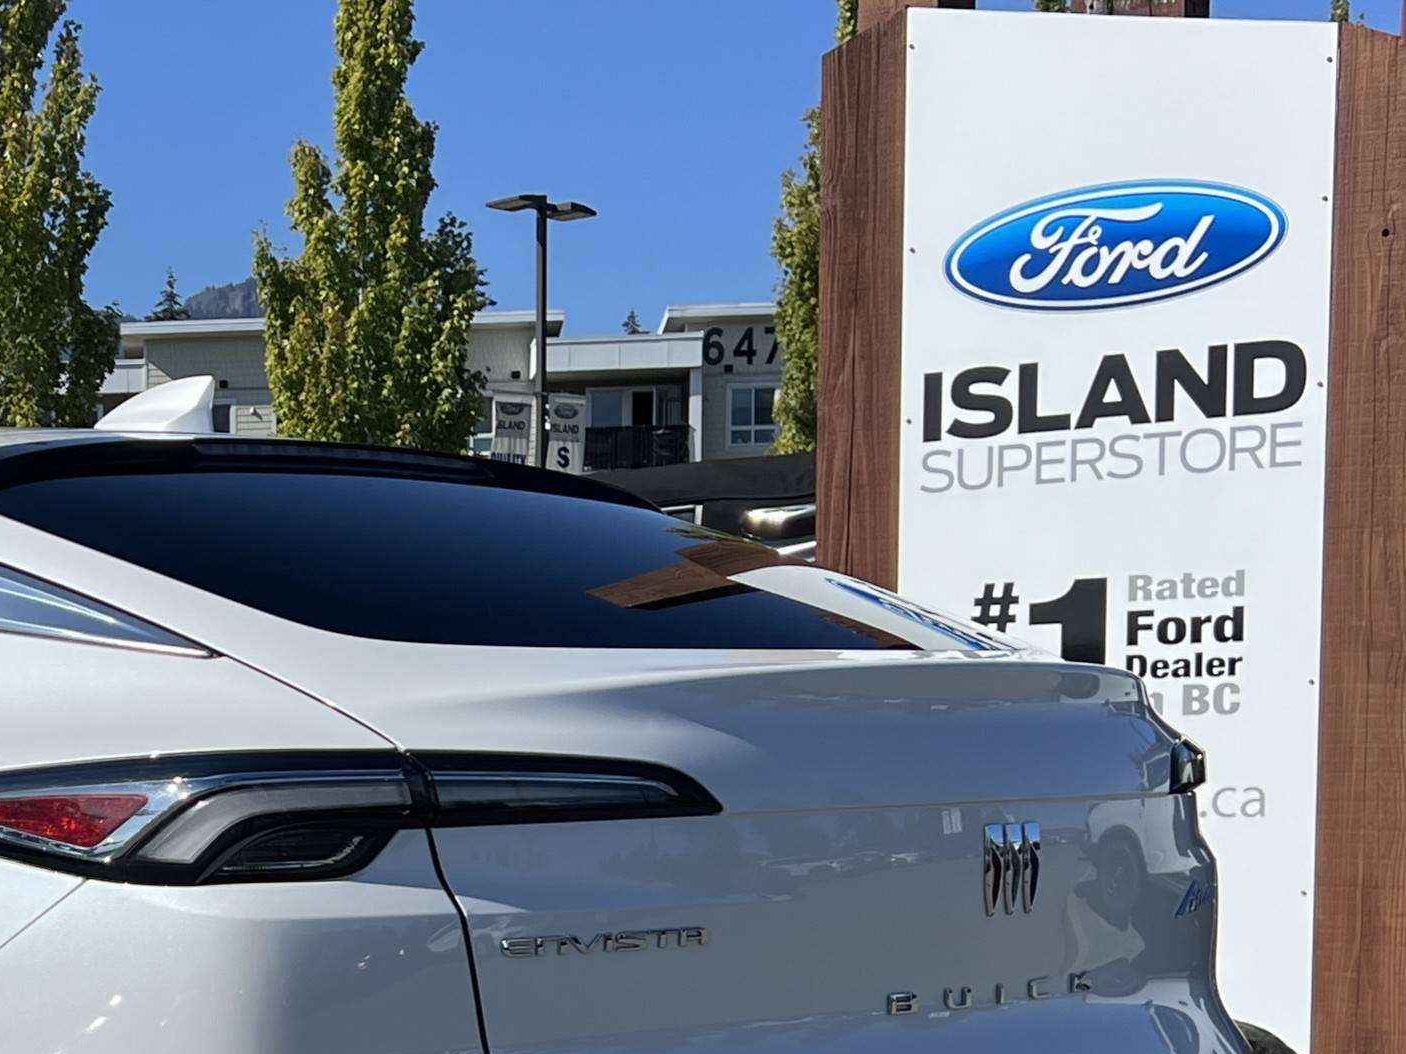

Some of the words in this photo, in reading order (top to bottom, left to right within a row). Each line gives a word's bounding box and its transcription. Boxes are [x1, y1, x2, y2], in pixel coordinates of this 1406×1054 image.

[1009, 201, 1216, 294] Ford
[922, 339, 1308, 443] ISLAND
[920, 421, 1303, 494] SUPERSTORE
[1127, 569, 1246, 602] Rated
[971, 576, 1108, 665] #1
[1126, 605, 1245, 647] Ford
[1125, 652, 1244, 679] Dealer
[1182, 682, 1241, 716] BC
[500, 926, 712, 959] ENVISTA
[887, 969, 1092, 1016] BUICK
